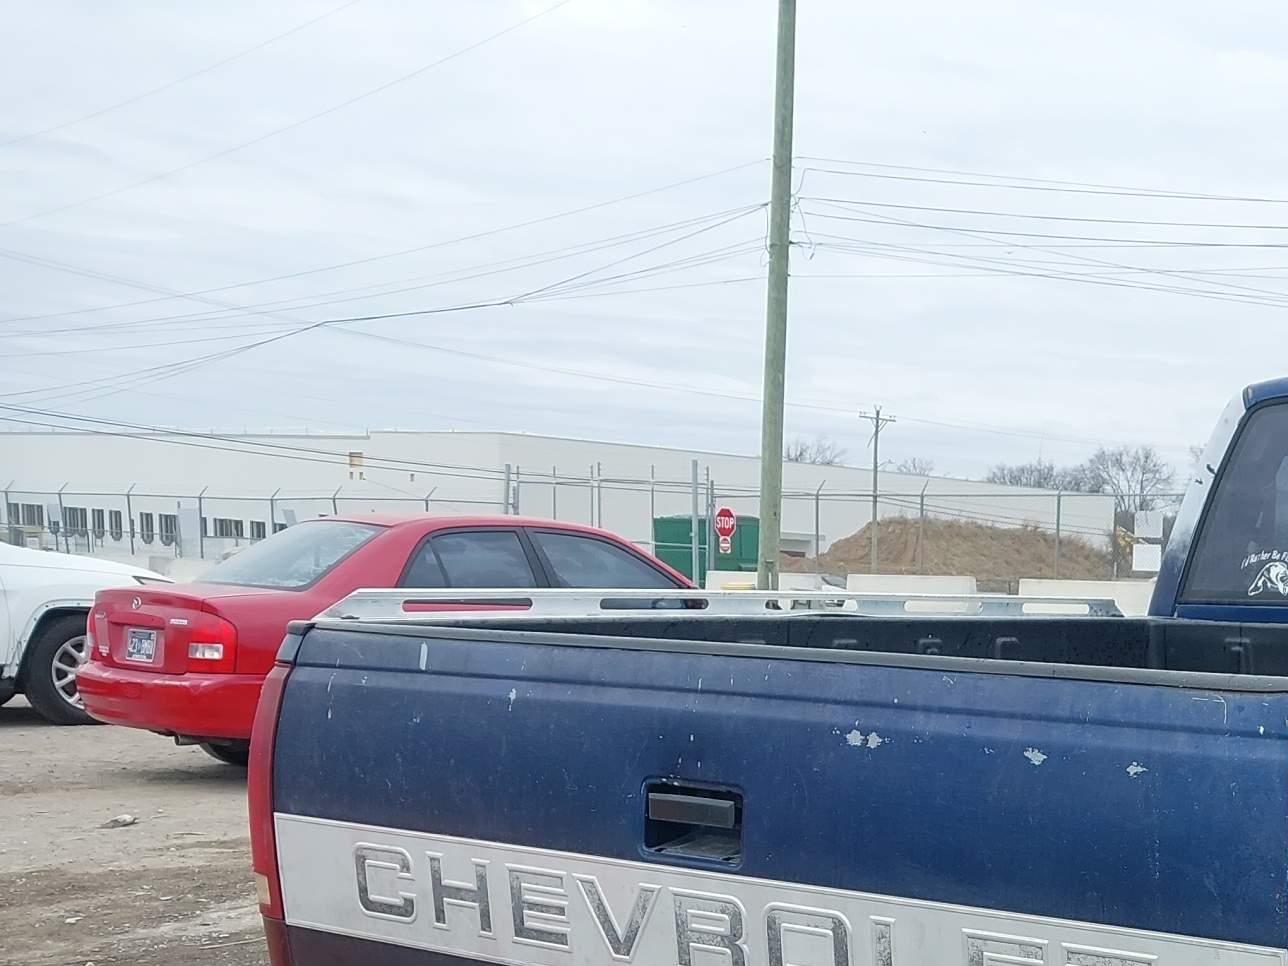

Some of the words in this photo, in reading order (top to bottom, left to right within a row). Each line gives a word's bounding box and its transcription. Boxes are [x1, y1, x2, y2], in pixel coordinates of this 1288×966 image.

[716, 517, 734, 529] STOP
[1249, 550, 1271, 564] Rather
[1271, 550, 1281, 560] Be
